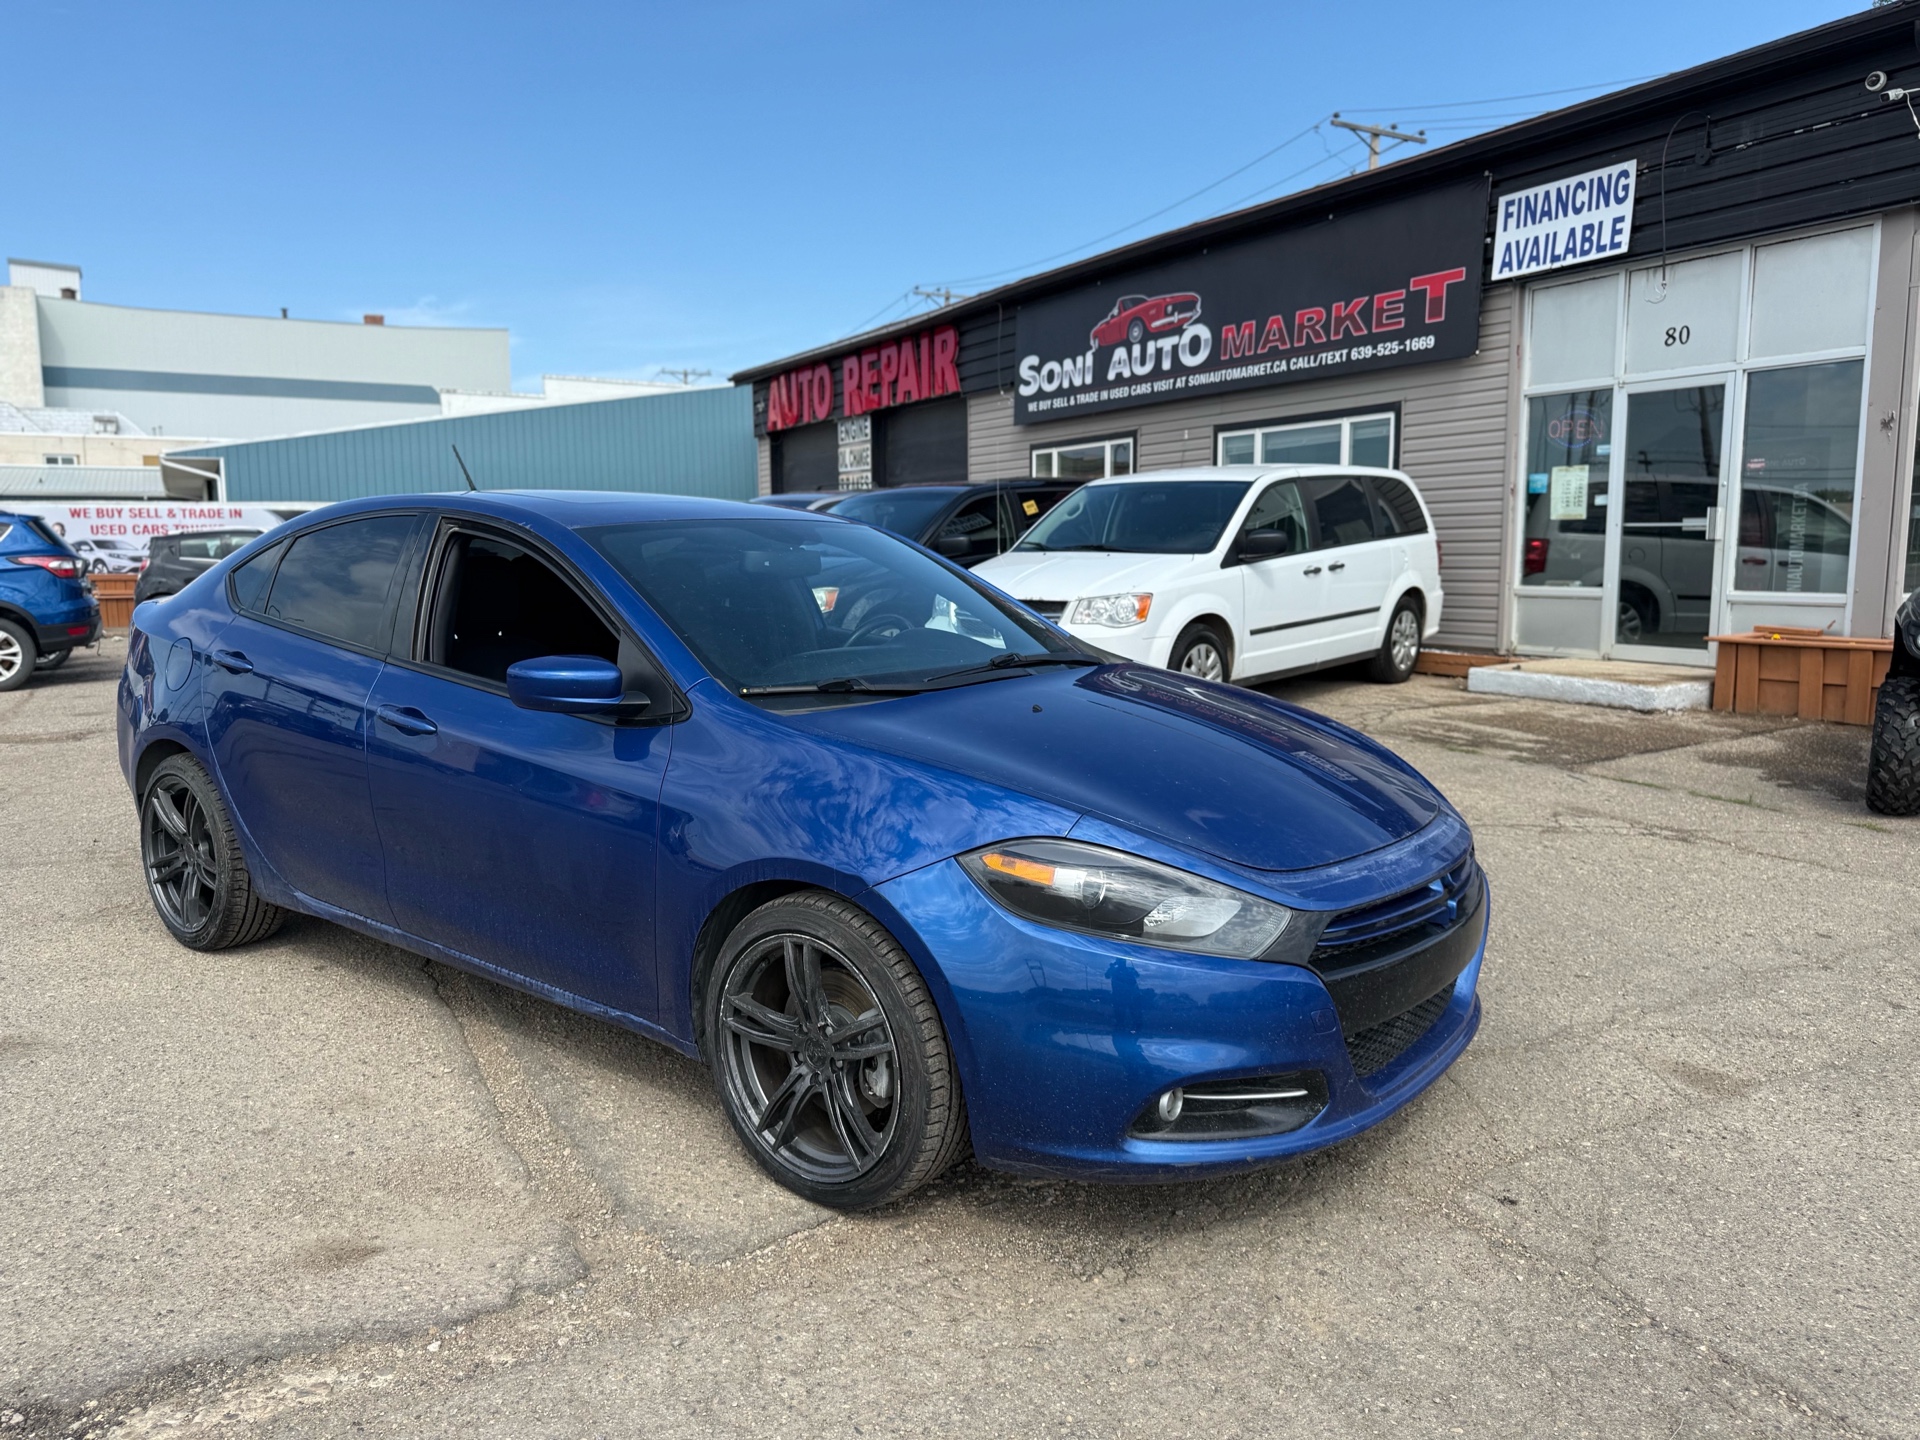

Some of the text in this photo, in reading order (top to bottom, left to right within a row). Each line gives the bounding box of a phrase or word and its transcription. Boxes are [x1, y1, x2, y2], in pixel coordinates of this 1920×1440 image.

[1502, 168, 1631, 232] FINANCING
[1498, 215, 1626, 275] AVAILABLE
[1018, 267, 1467, 397] SONI AUTO MARKET
[1664, 325, 1691, 347] 80
[766, 325, 961, 431] AUTO REPAIR
[1027, 335, 1435, 412] WE BUY SELL & TRADE IN USED CARS VISIT AT SONIAUTOMARKET.CA CALL/TEXT 639-525-1669
[840, 417, 869, 442] ENGINE
[1548, 419, 1605, 439] OPEN
[68, 507, 243, 519] WE BUY SELL & TRADE IN
[90, 524, 127, 536] USED
[132, 524, 169, 536] CARS
